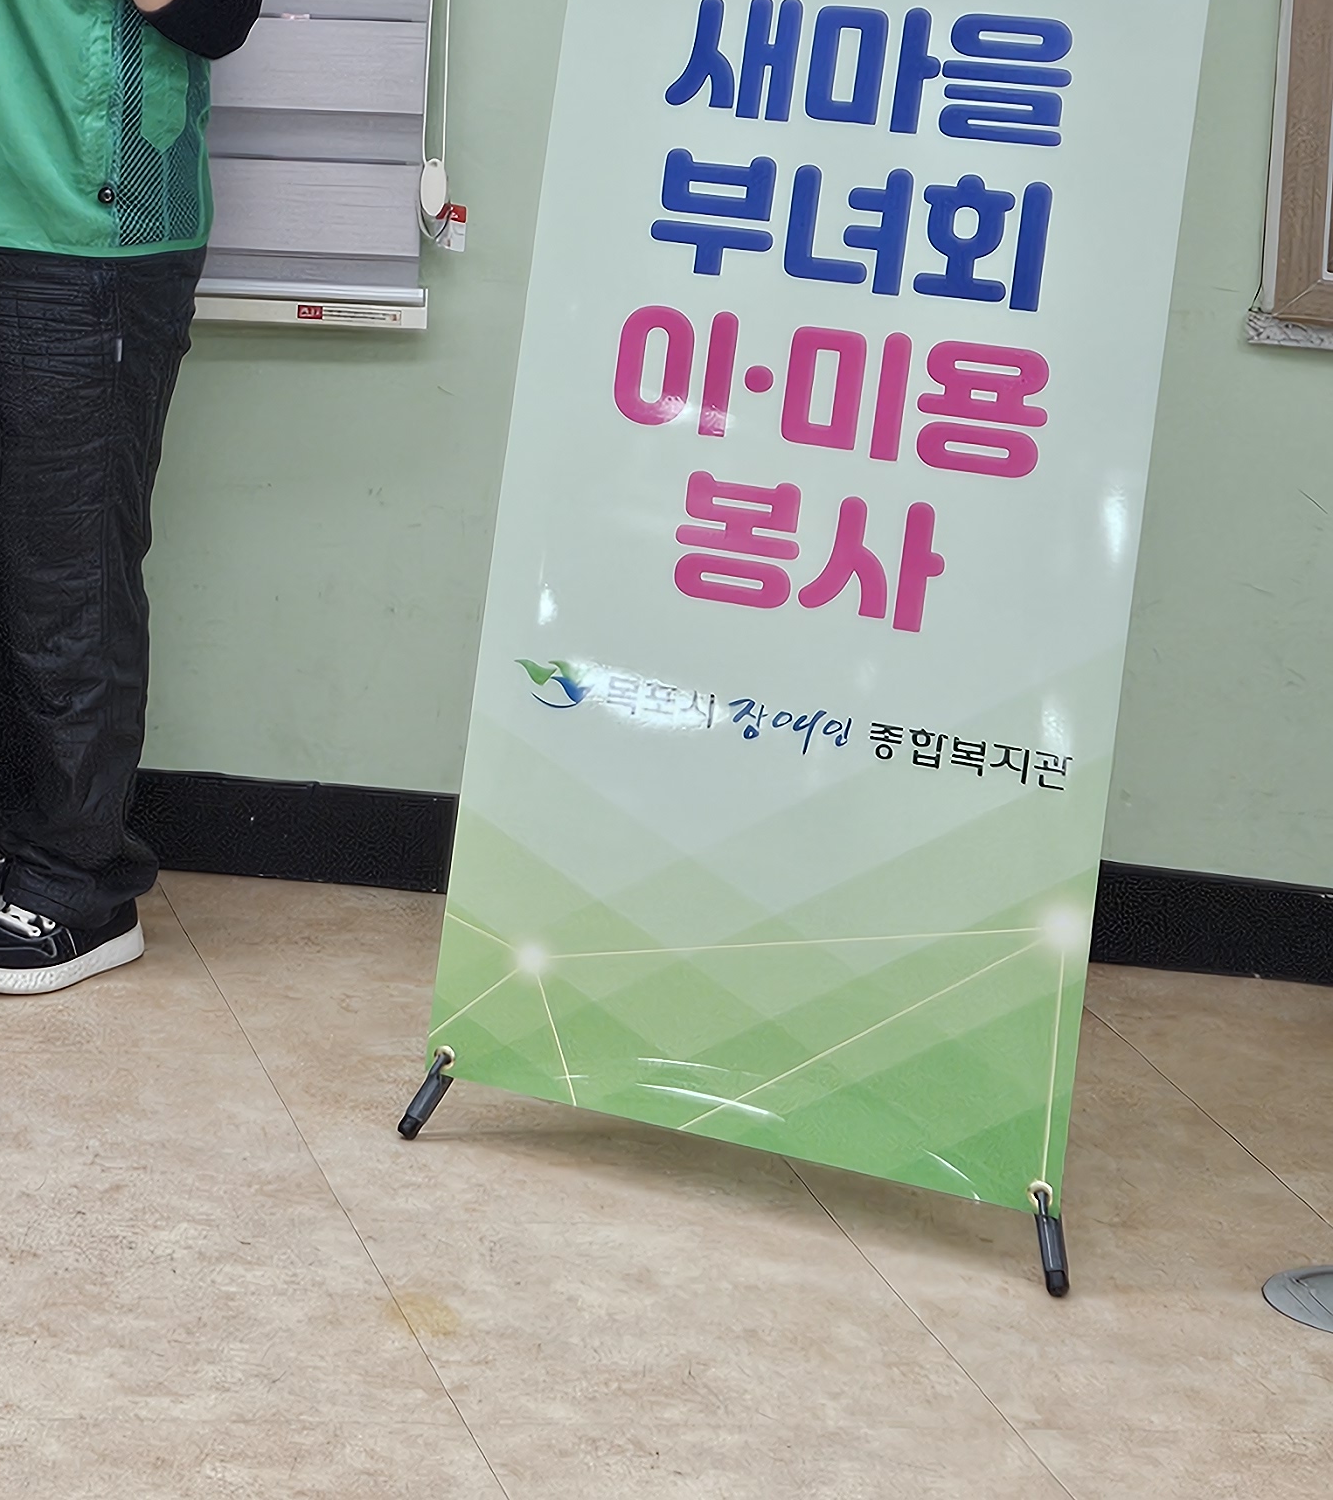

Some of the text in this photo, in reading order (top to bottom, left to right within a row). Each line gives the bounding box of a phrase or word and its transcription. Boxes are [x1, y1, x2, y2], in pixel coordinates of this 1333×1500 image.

[650, 148, 1053, 313] 부녀회
[613, 304, 1050, 478] 이·미용
[673, 470, 946, 633] 봉사
[606, 675, 1073, 791] 목포시 장애인 종합복지관
